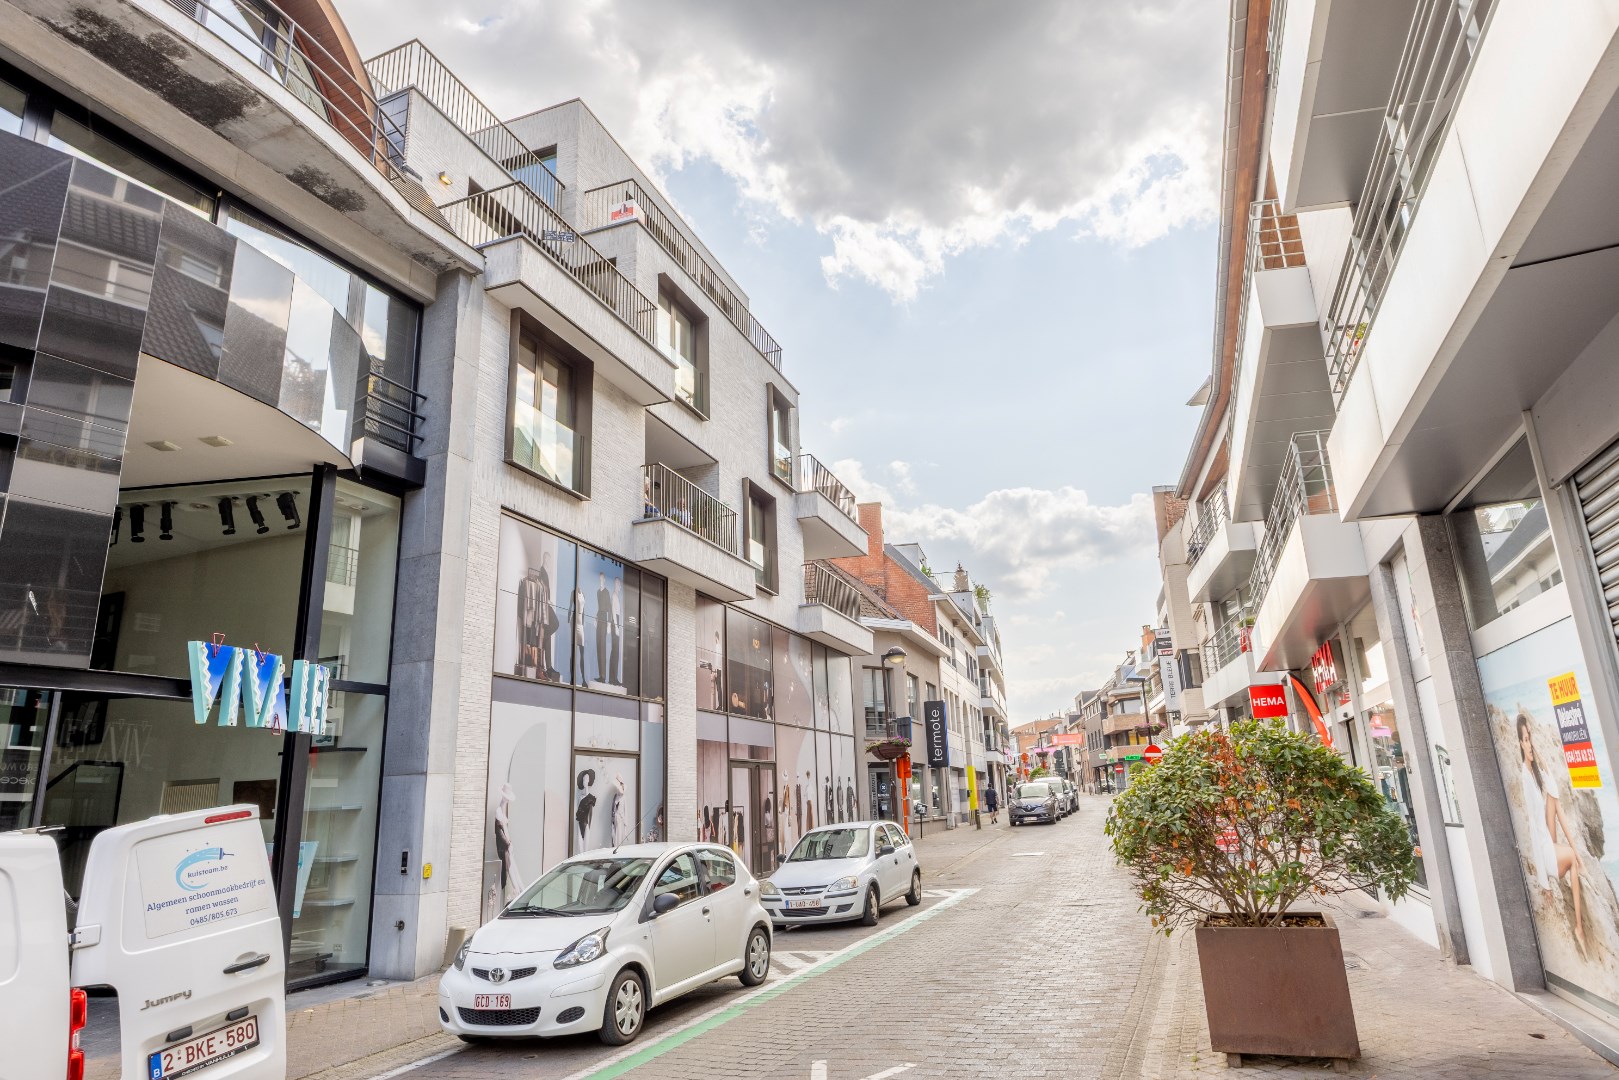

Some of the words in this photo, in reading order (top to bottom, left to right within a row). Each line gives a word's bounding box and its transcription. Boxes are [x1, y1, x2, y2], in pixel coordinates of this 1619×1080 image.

[1549, 682, 1559, 700] TE
[1559, 676, 1578, 698] HUUR
[1253, 697, 1284, 706] HEMA
[147, 897, 188, 912] Algemeen
[185, 903, 211, 914] ramen
[212, 896, 239, 908] wassen
[153, 1068, 161, 1078] B
